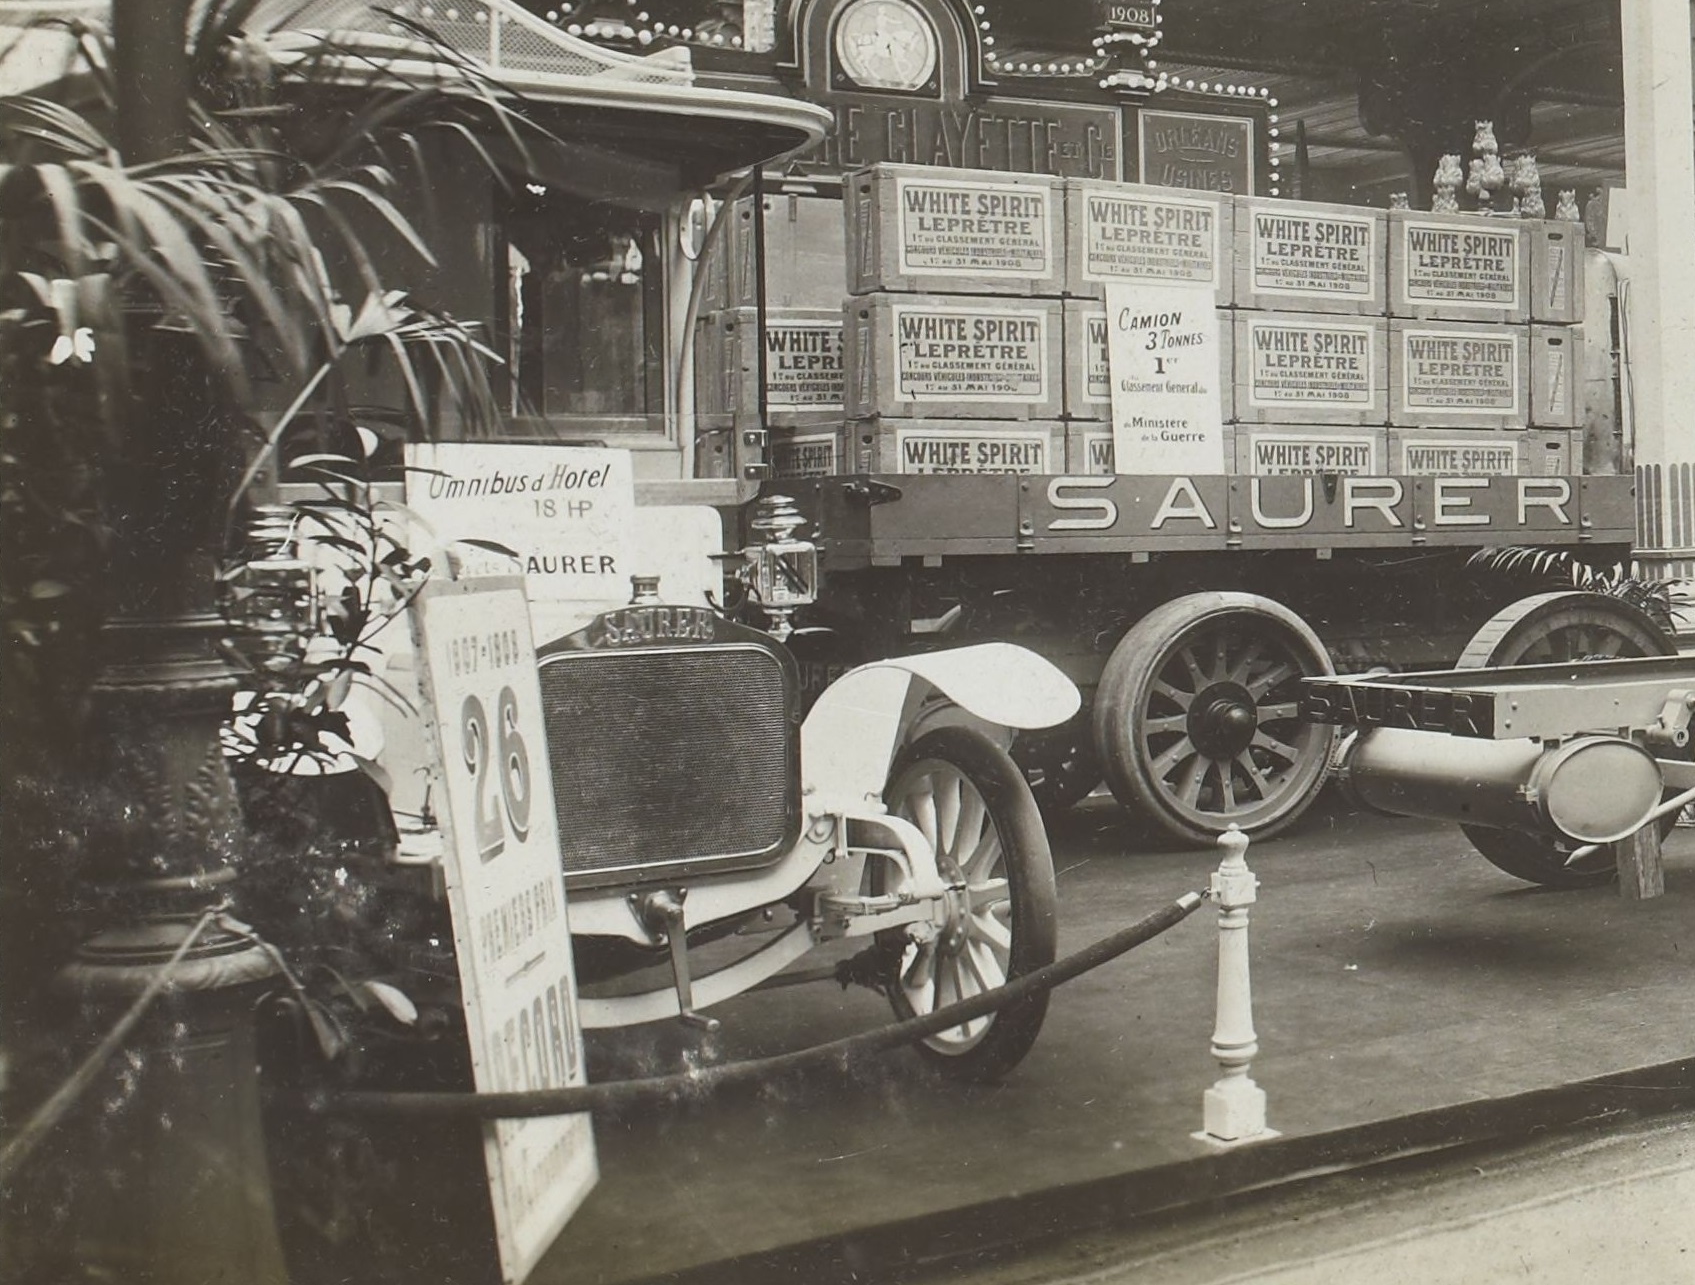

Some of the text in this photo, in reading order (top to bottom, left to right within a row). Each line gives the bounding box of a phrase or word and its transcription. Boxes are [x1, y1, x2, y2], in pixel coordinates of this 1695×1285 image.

[1111, 6, 1149, 24] 1908
[906, 190, 1042, 218] WHITE SPIRIT
[918, 216, 1032, 235] LEPRÊTRE
[1090, 201, 1212, 232] WHITE SPIRIT
[936, 235, 995, 244] CLASSEMENT
[1257, 218, 1369, 246] WHITE SPIRIT
[1116, 245, 1170, 255] CLASSEMENT
[1410, 231, 1513, 257] WHITE SPIRIT
[996, 259, 1022, 267] 1908
[1281, 259, 1329, 269] CLASSEMENT
[902, 317, 1038, 342] WHITE SPIRIT
[767, 331, 832, 352] WHITE
[914, 342, 1028, 359] LEPRÊTRE
[1145, 331, 1157, 351] 3
[1255, 330, 1367, 354] WHITE SPIRIT
[1410, 340, 1513, 362] WHITE SPIRIT
[779, 355, 844, 370] LEPR
[932, 361, 991, 370] CLASSEMENT
[1160, 430, 1206, 443] Guerre
[905, 442, 1041, 465] WHITE SPIRIT
[1258, 445, 1369, 466] WHITE SPIRIT
[1409, 450, 1511, 470] WHITE SPIRIT
[429, 470, 529, 499] Omnibus
[534, 499, 593, 518] 18 HP
[1046, 477, 1572, 530] SAURER
[525, 555, 617, 574] AURER
[604, 607, 715, 647] SAURER
[461, 685, 531, 865] 26
